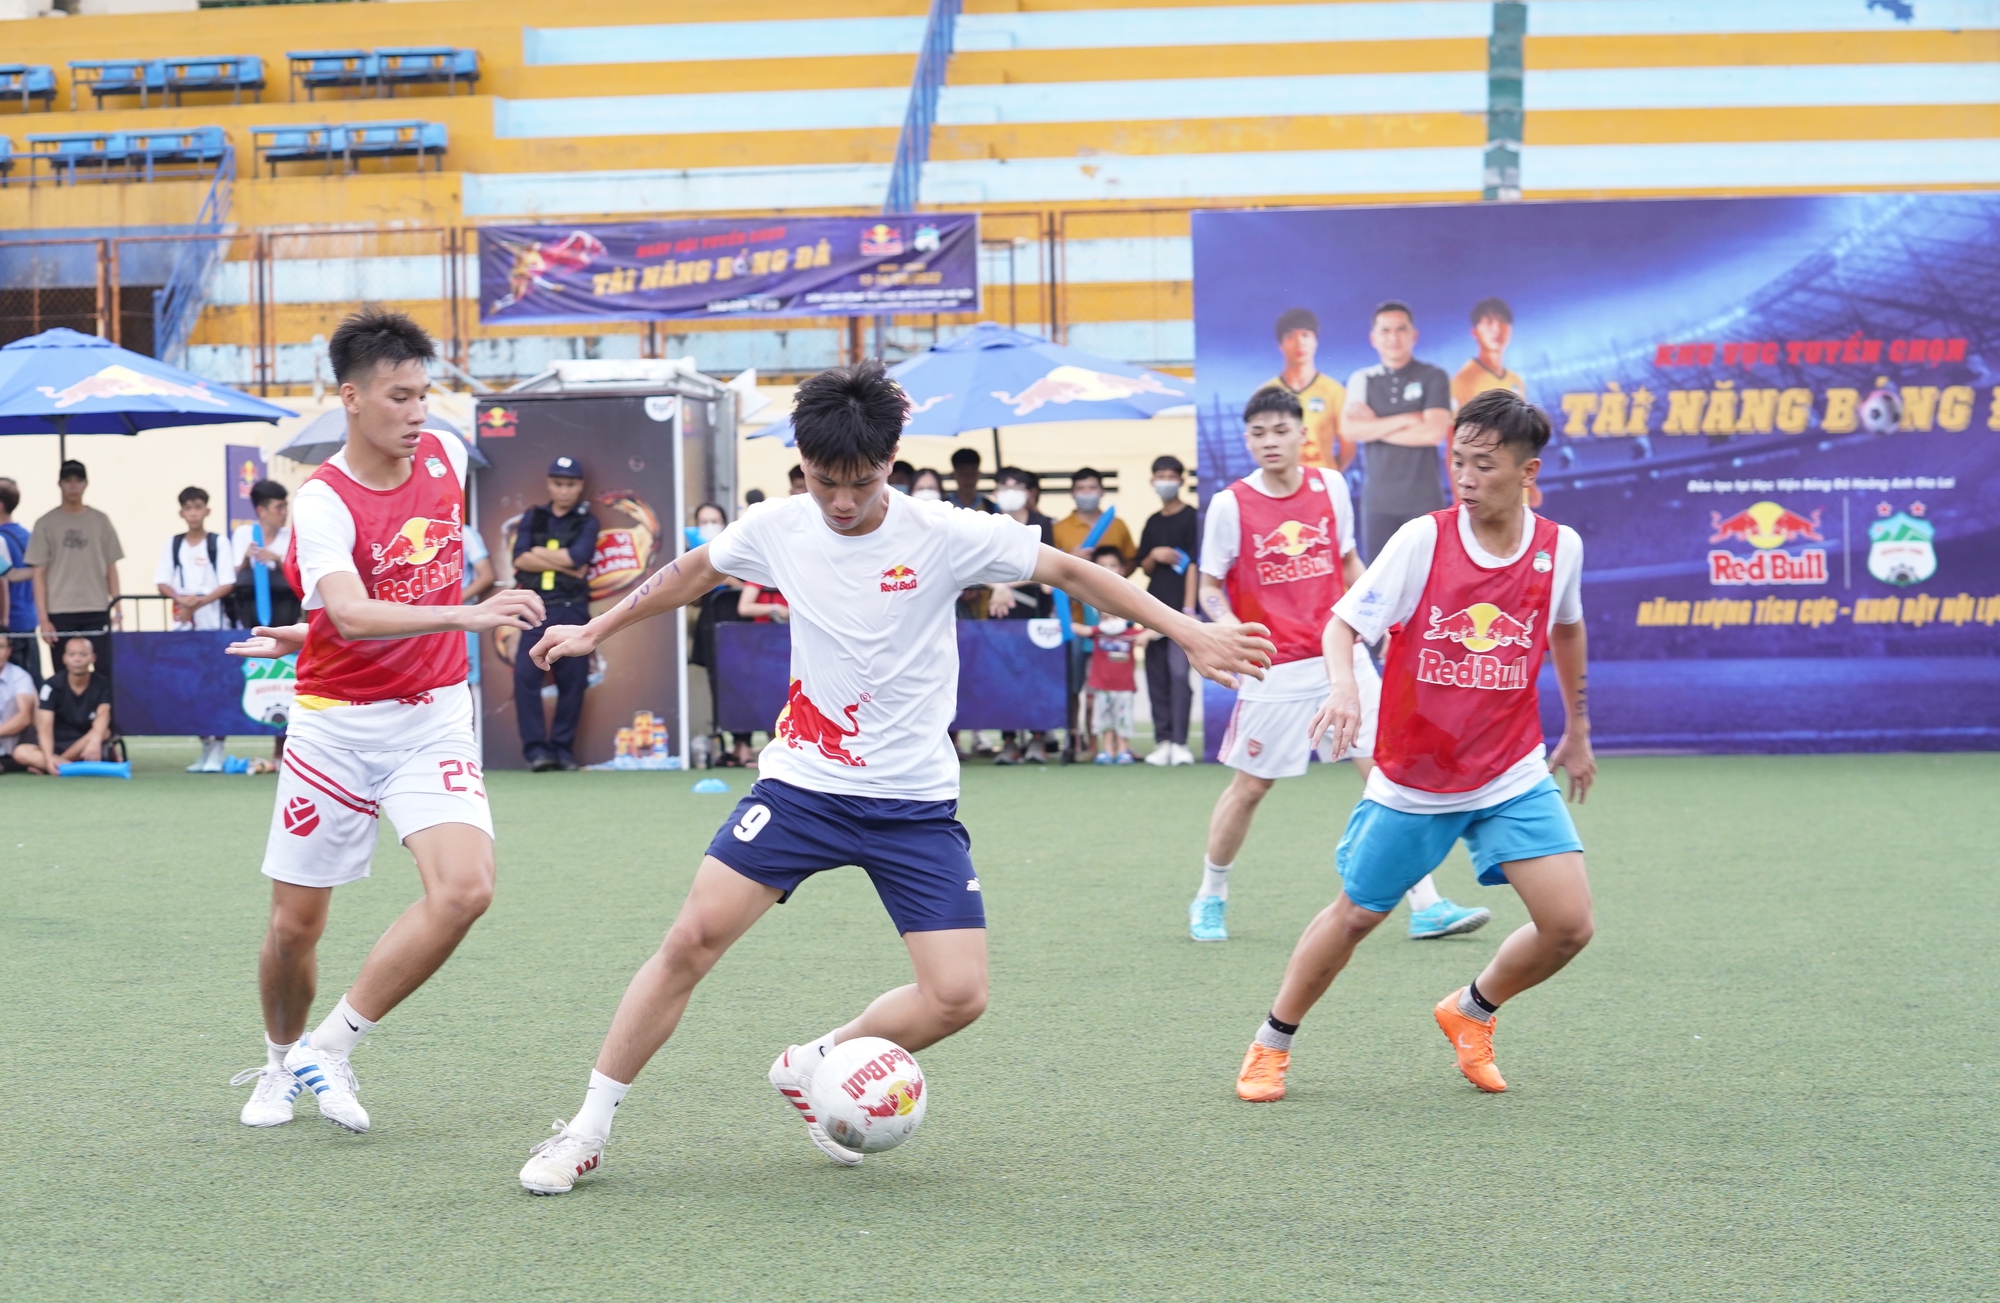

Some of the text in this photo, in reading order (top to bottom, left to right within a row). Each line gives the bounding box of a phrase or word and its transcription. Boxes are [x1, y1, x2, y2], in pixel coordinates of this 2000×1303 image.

[1654, 331, 1969, 371] KHU VỰC TUYỂN CHỌN
[1562, 382, 1656, 437] TÀI
[1662, 381, 1814, 436] NĂNG
[373, 567, 427, 604] Red
[881, 579, 917, 592] Red Bull
[1257, 557, 1298, 585] Red
[1710, 549, 1827, 585] Red Bull
[1754, 595, 1798, 627] TÍCH
[1976, 595, 2000, 627] LỰ
[1417, 648, 1529, 690] Red Bull
[733, 804, 771, 842] 9
[842, 1048, 916, 1100] Red Bull
